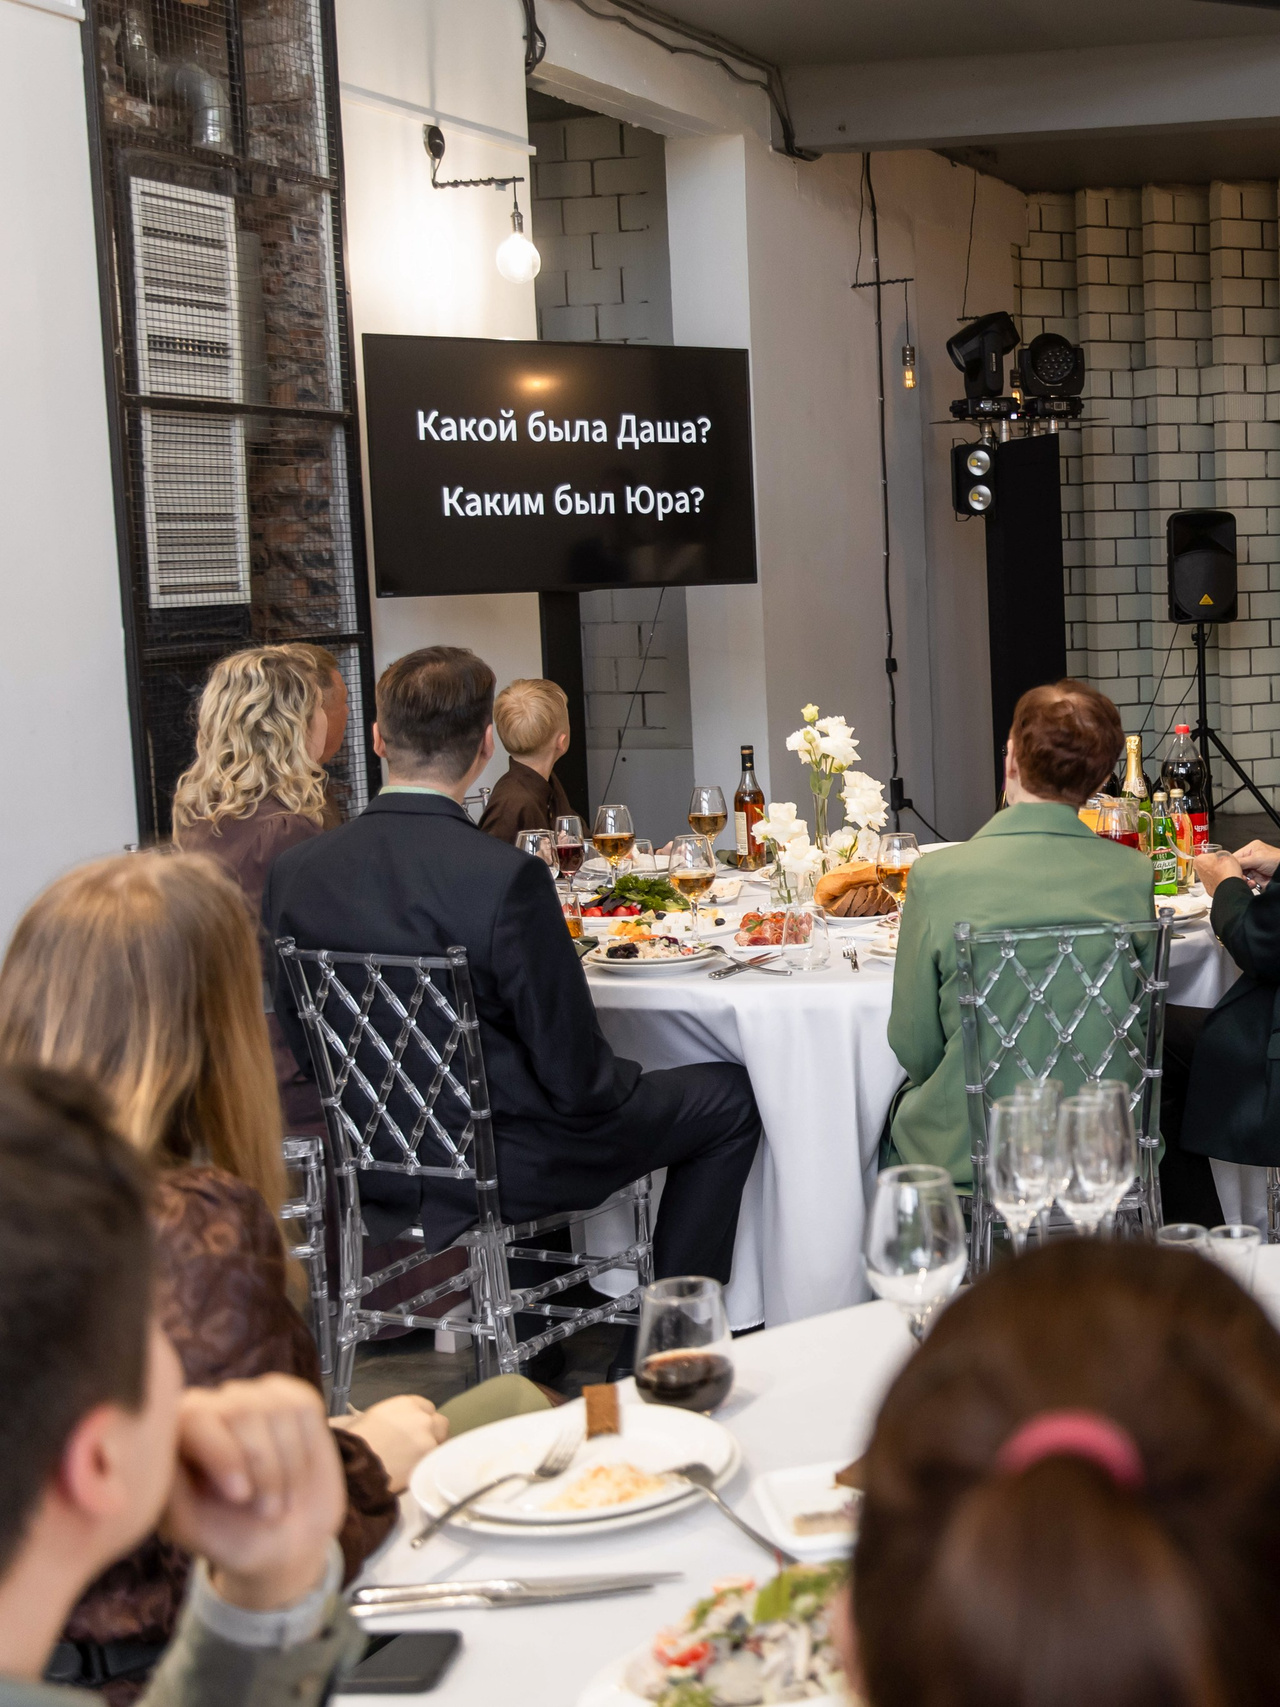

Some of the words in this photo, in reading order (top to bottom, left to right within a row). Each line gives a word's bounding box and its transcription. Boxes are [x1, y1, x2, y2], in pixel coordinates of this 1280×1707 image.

[418, 409, 517, 441] Какой
[528, 410, 607, 442] была
[617, 415, 711, 449] Даша?
[443, 487, 544, 516] Каким
[555, 484, 615, 515] был
[626, 486, 704, 521] Юра?
